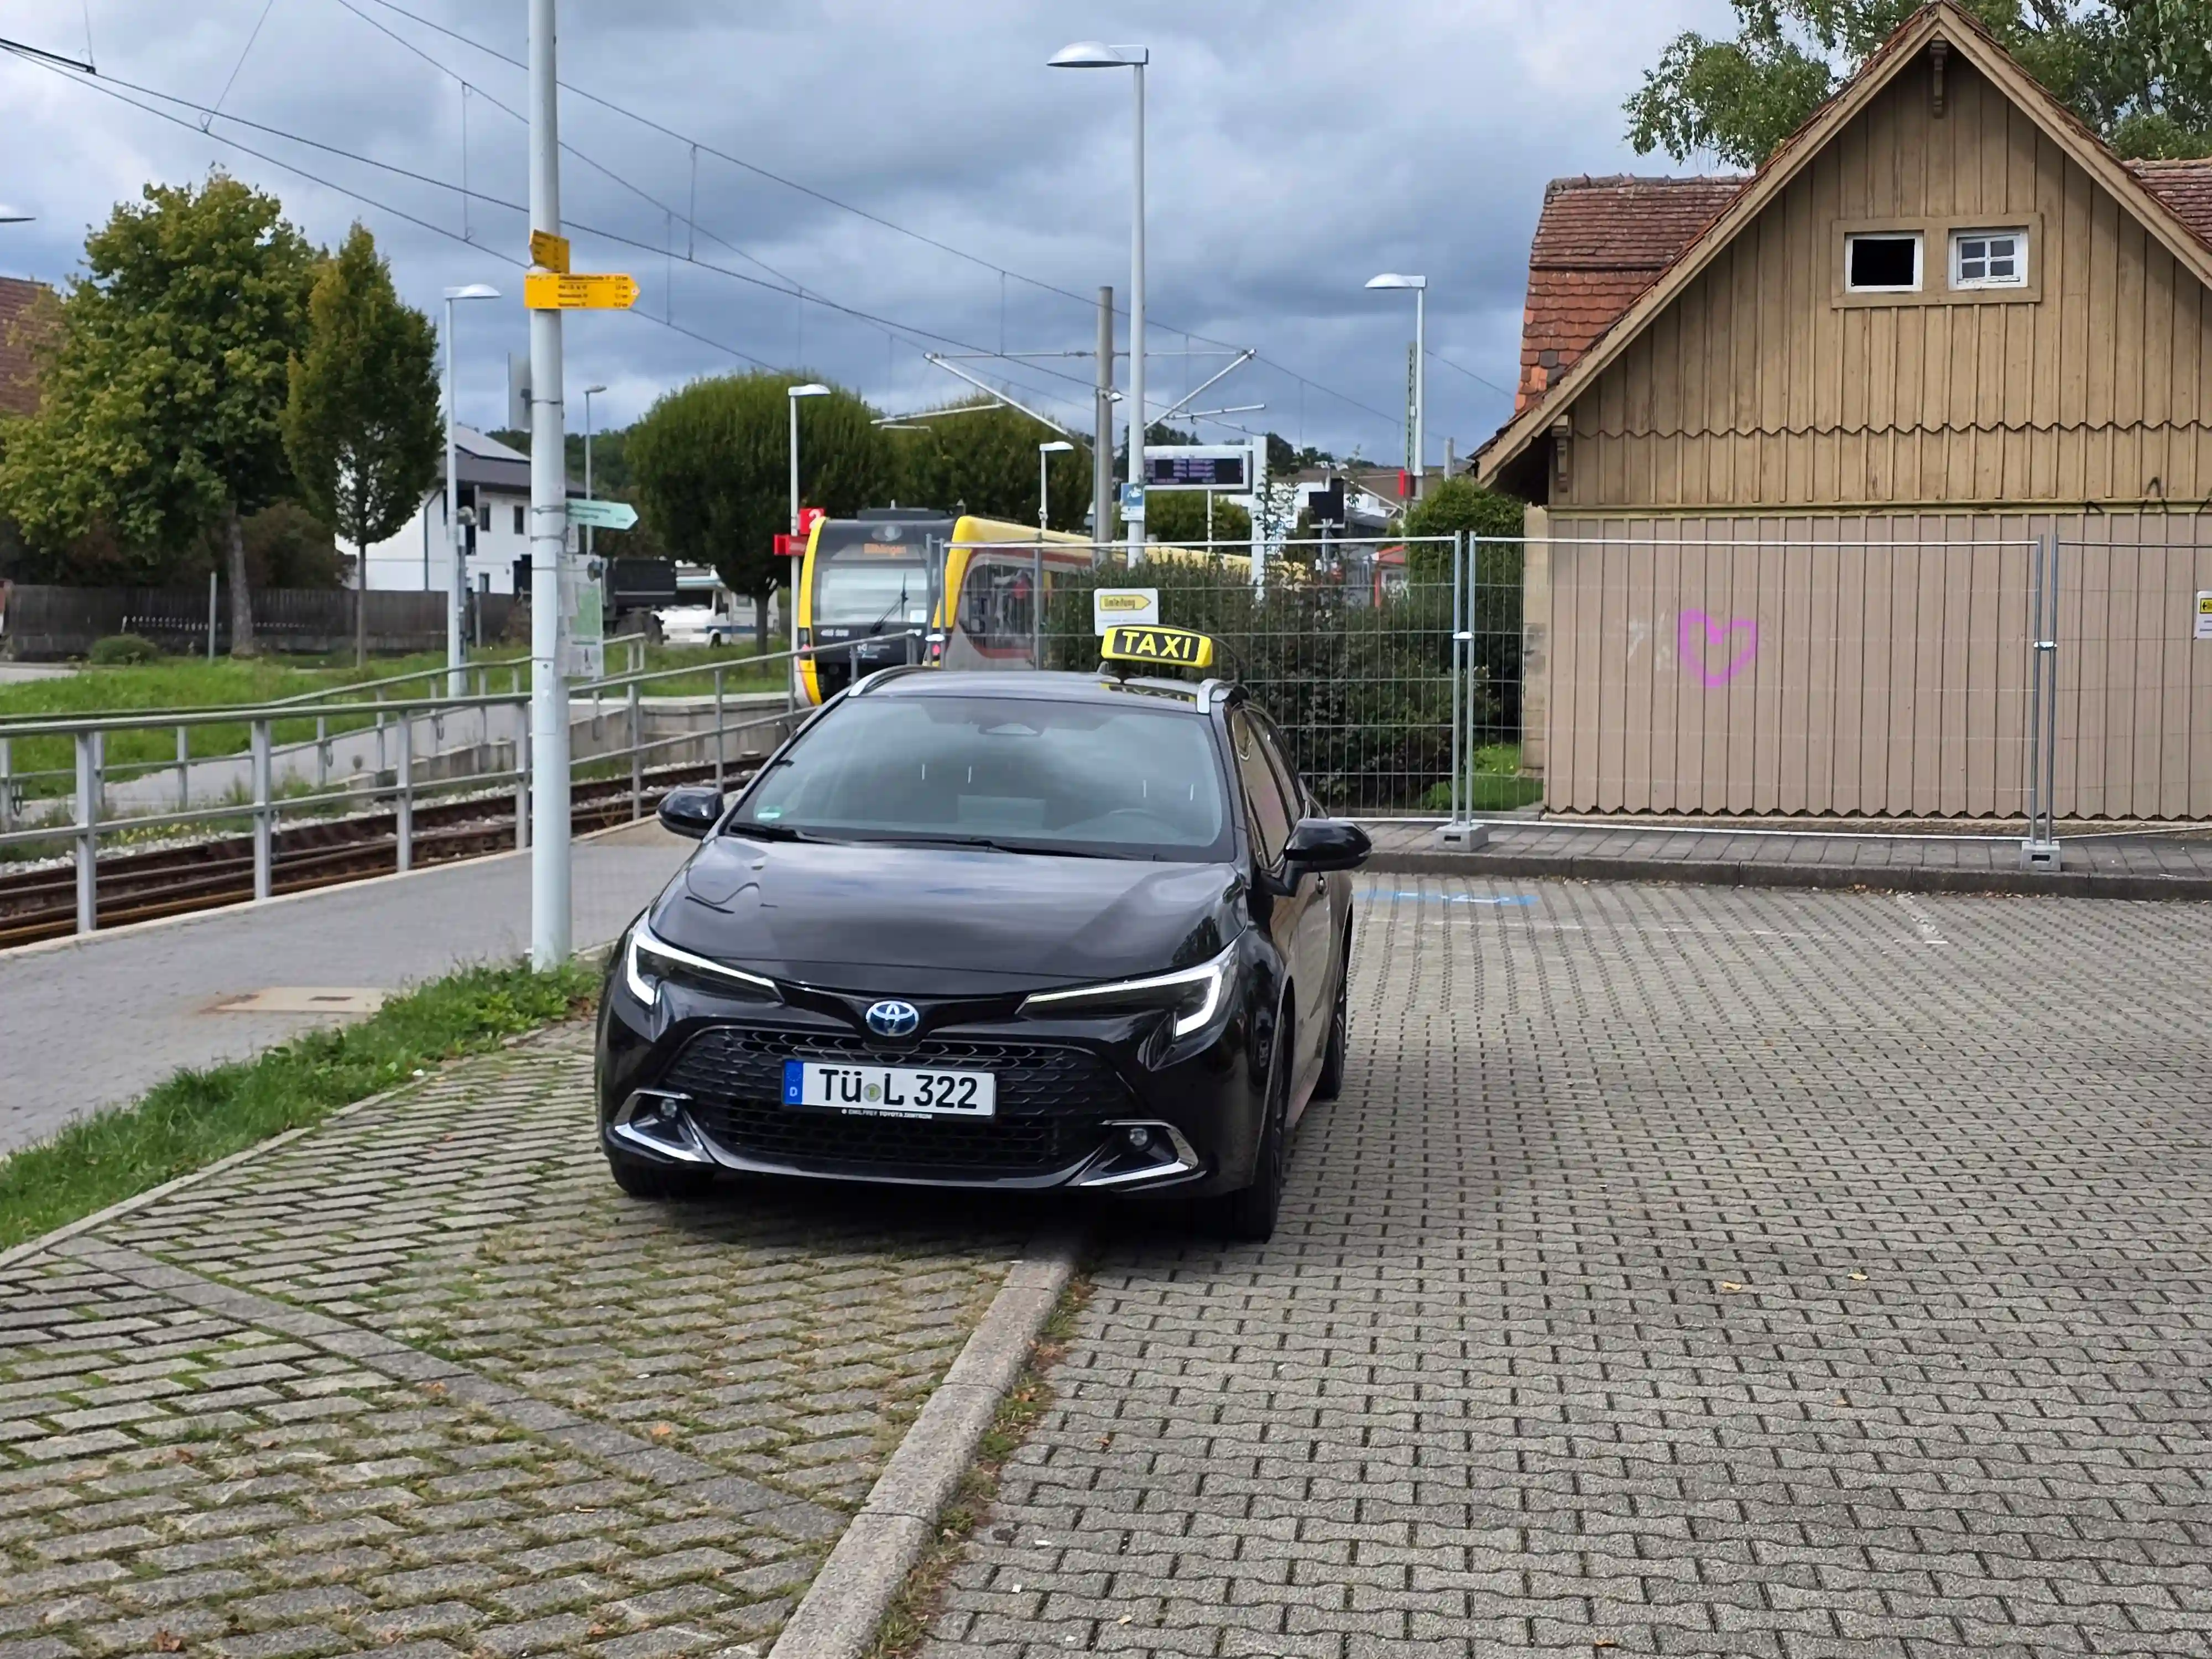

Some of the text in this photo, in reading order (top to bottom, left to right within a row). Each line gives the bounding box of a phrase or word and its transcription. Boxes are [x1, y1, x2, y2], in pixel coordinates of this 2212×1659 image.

[1122, 631, 1192, 659] TAXI
[790, 1069, 977, 1109] D TÜ L 322
